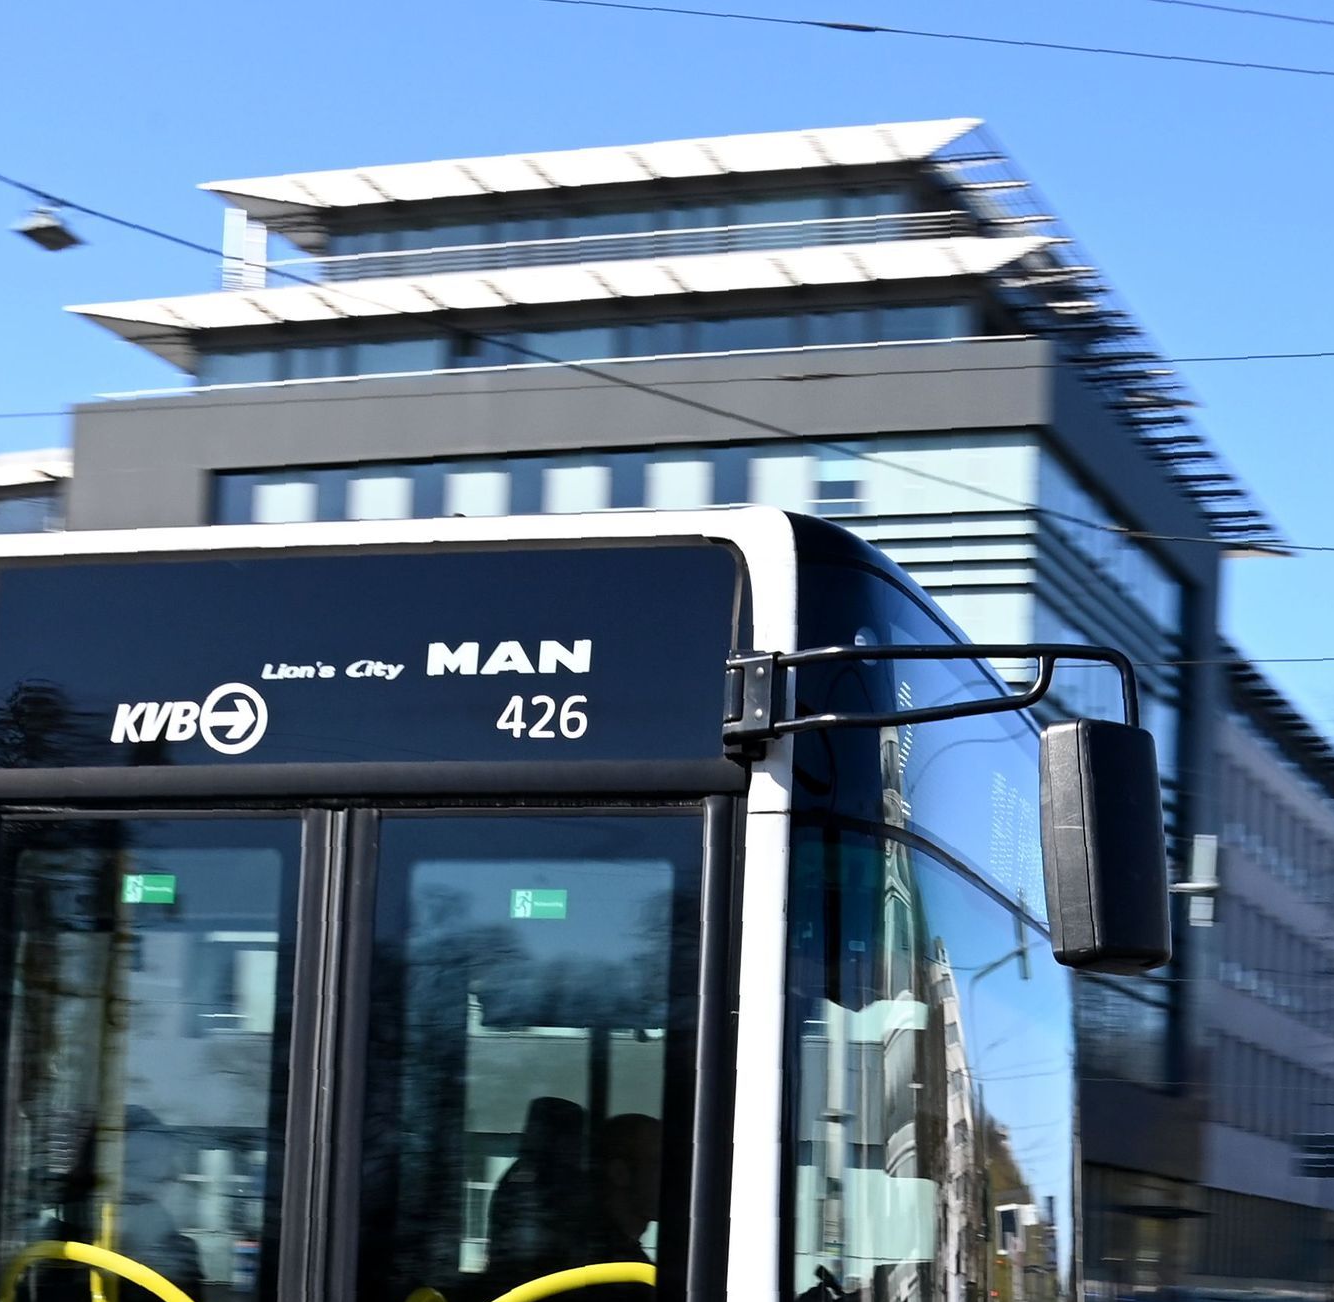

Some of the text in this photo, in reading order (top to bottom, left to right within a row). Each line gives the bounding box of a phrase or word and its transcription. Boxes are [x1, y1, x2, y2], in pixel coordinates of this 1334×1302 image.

[261, 660, 405, 681] Lion's City
[426, 640, 592, 676] MAN
[110, 701, 199, 744] KVB
[496, 694, 589, 739] 426
